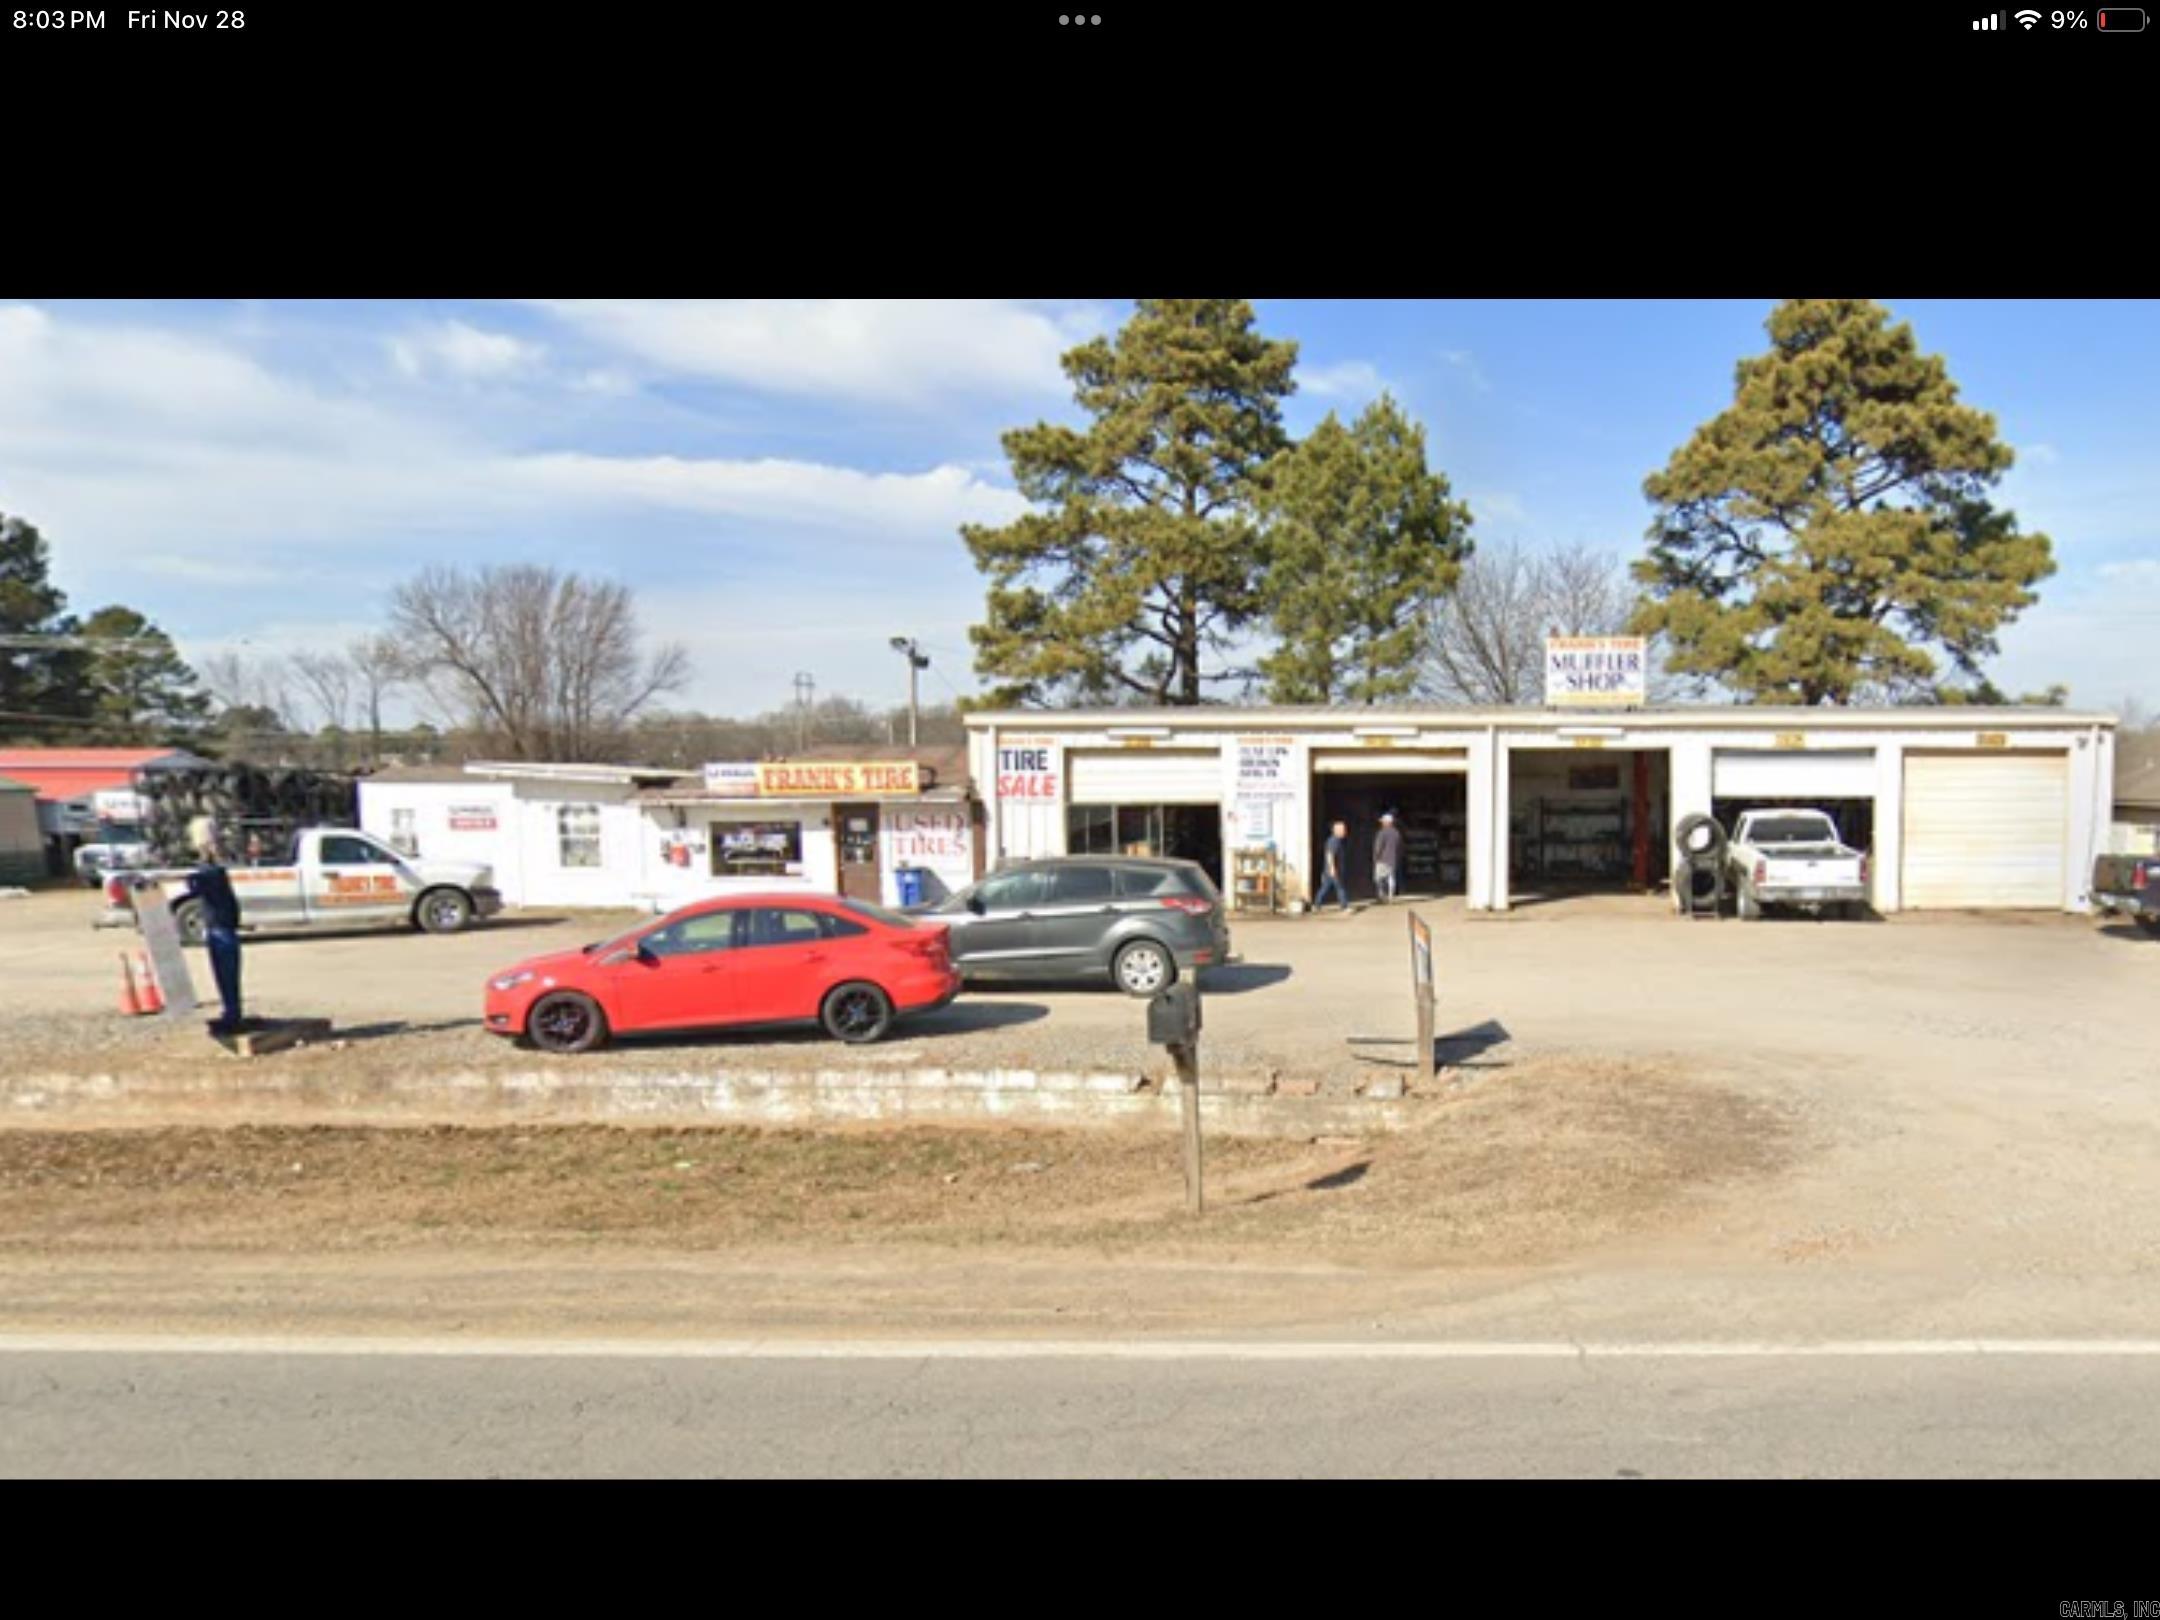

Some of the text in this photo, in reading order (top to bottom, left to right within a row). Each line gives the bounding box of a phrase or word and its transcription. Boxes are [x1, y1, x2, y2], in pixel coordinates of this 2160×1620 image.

[1551, 653, 1640, 672] MUFFLER
[1566, 672, 1624, 691] SHOP
[1000, 749, 1048, 771] TIRE
[763, 766, 855, 790] FRANK'S
[861, 766, 914, 790] TIRE
[996, 774, 1057, 797] SALE
[895, 813, 964, 831] USED
[895, 837, 967, 856] TIRES
